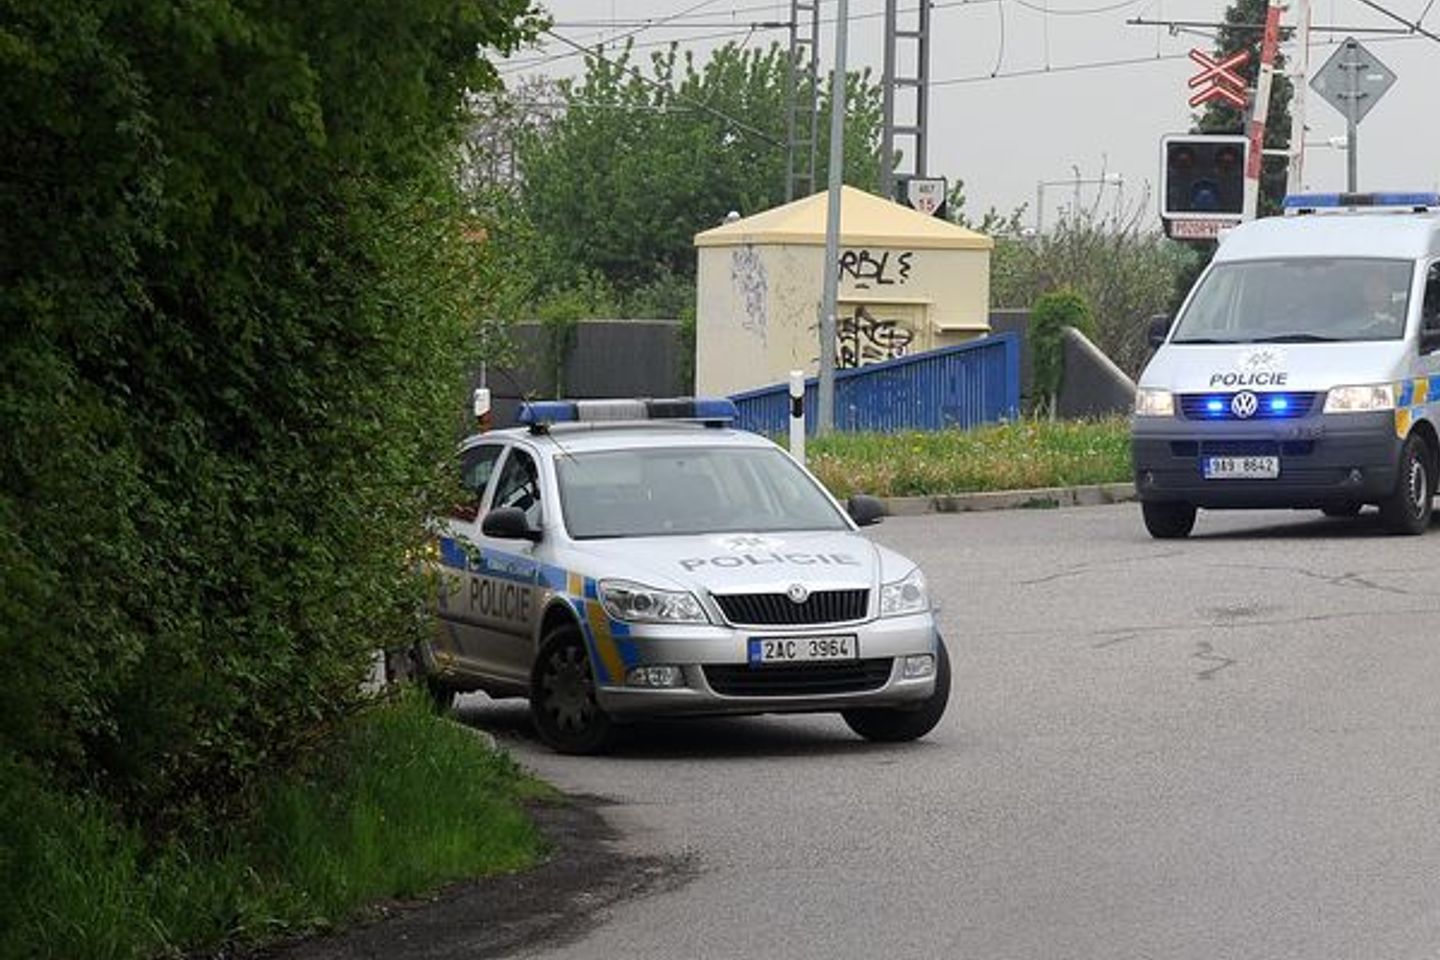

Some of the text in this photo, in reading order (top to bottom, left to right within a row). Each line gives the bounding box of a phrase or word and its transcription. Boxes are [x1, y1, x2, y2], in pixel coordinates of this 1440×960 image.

[1210, 371, 1288, 387] POLICIE
[679, 553, 862, 573] POLICIE
[470, 576, 531, 622] POLICIE
[764, 639, 849, 659] 2AC 3964
